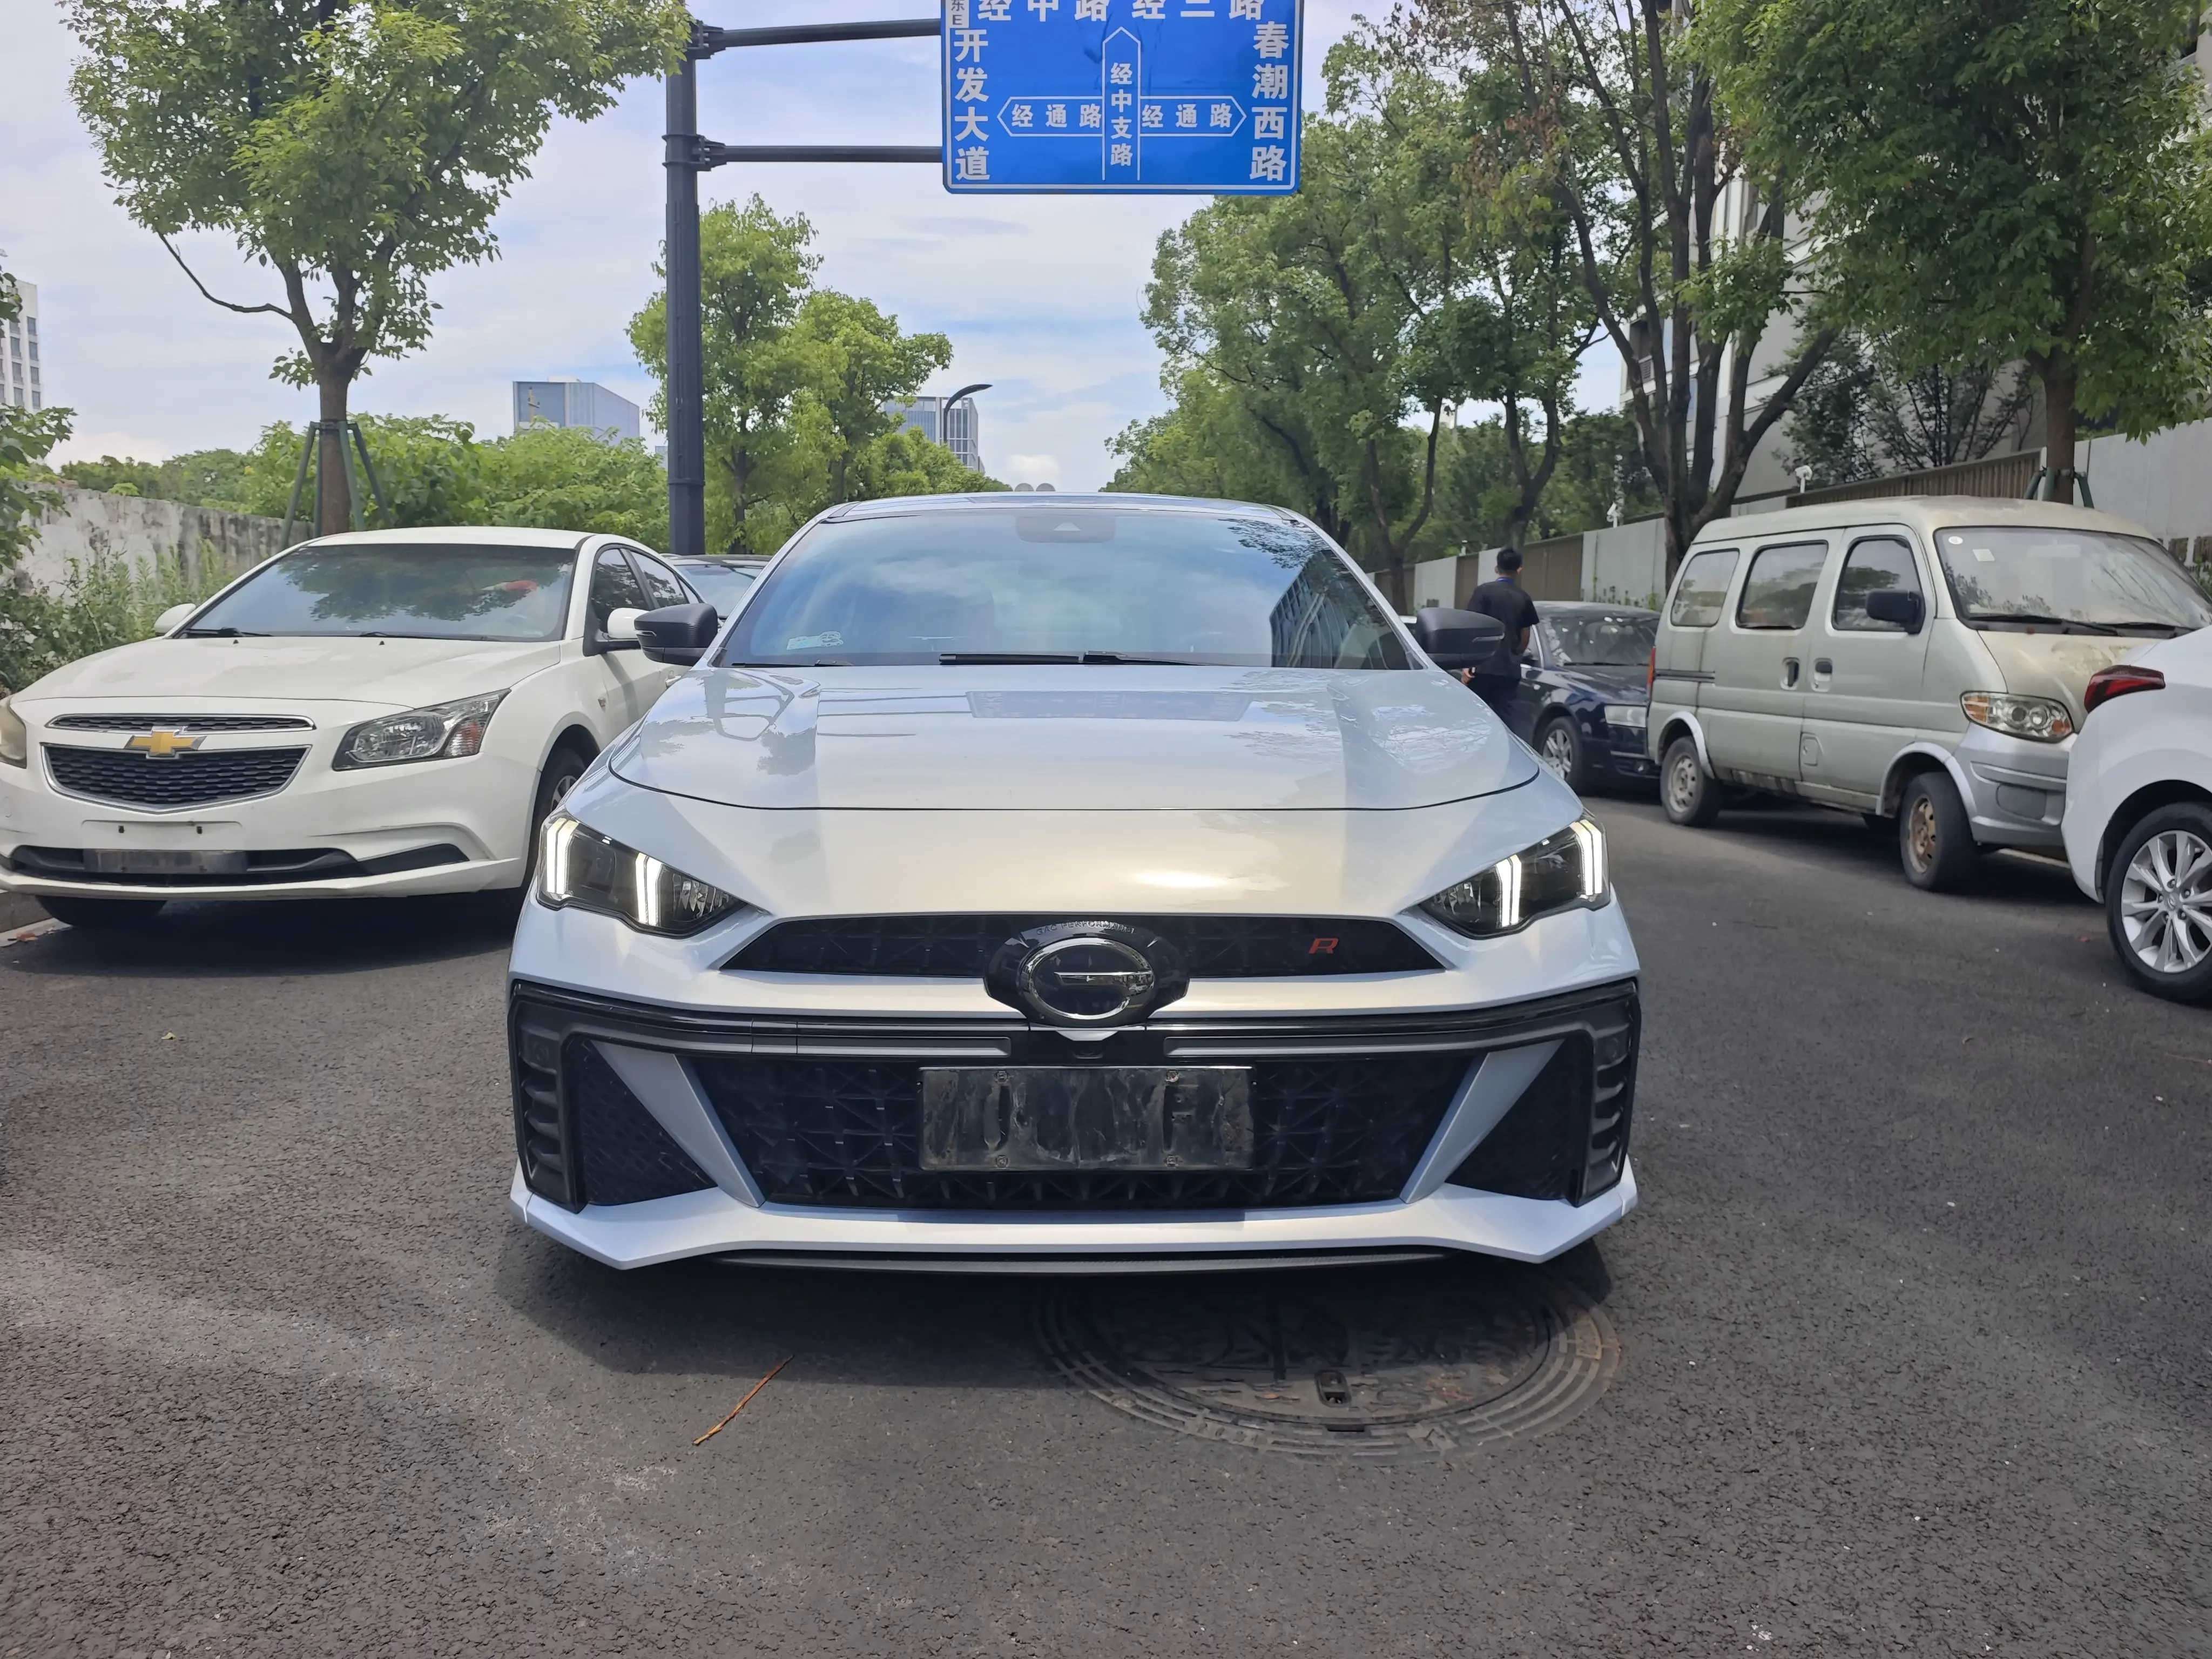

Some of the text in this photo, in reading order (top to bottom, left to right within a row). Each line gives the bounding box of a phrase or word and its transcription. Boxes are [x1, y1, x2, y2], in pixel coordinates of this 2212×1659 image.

[952, 15, 962, 25] E
[954, 29, 990, 181] 开发大道
[1250, 21, 1289, 181] 春潮西路
[1011, 104, 1102, 128] 经通路
[1110, 62, 1132, 166] 经中支路
[1142, 104, 1233, 128] 经通路
[1036, 924, 1057, 935] GAC
[1309, 938, 1339, 954] R
